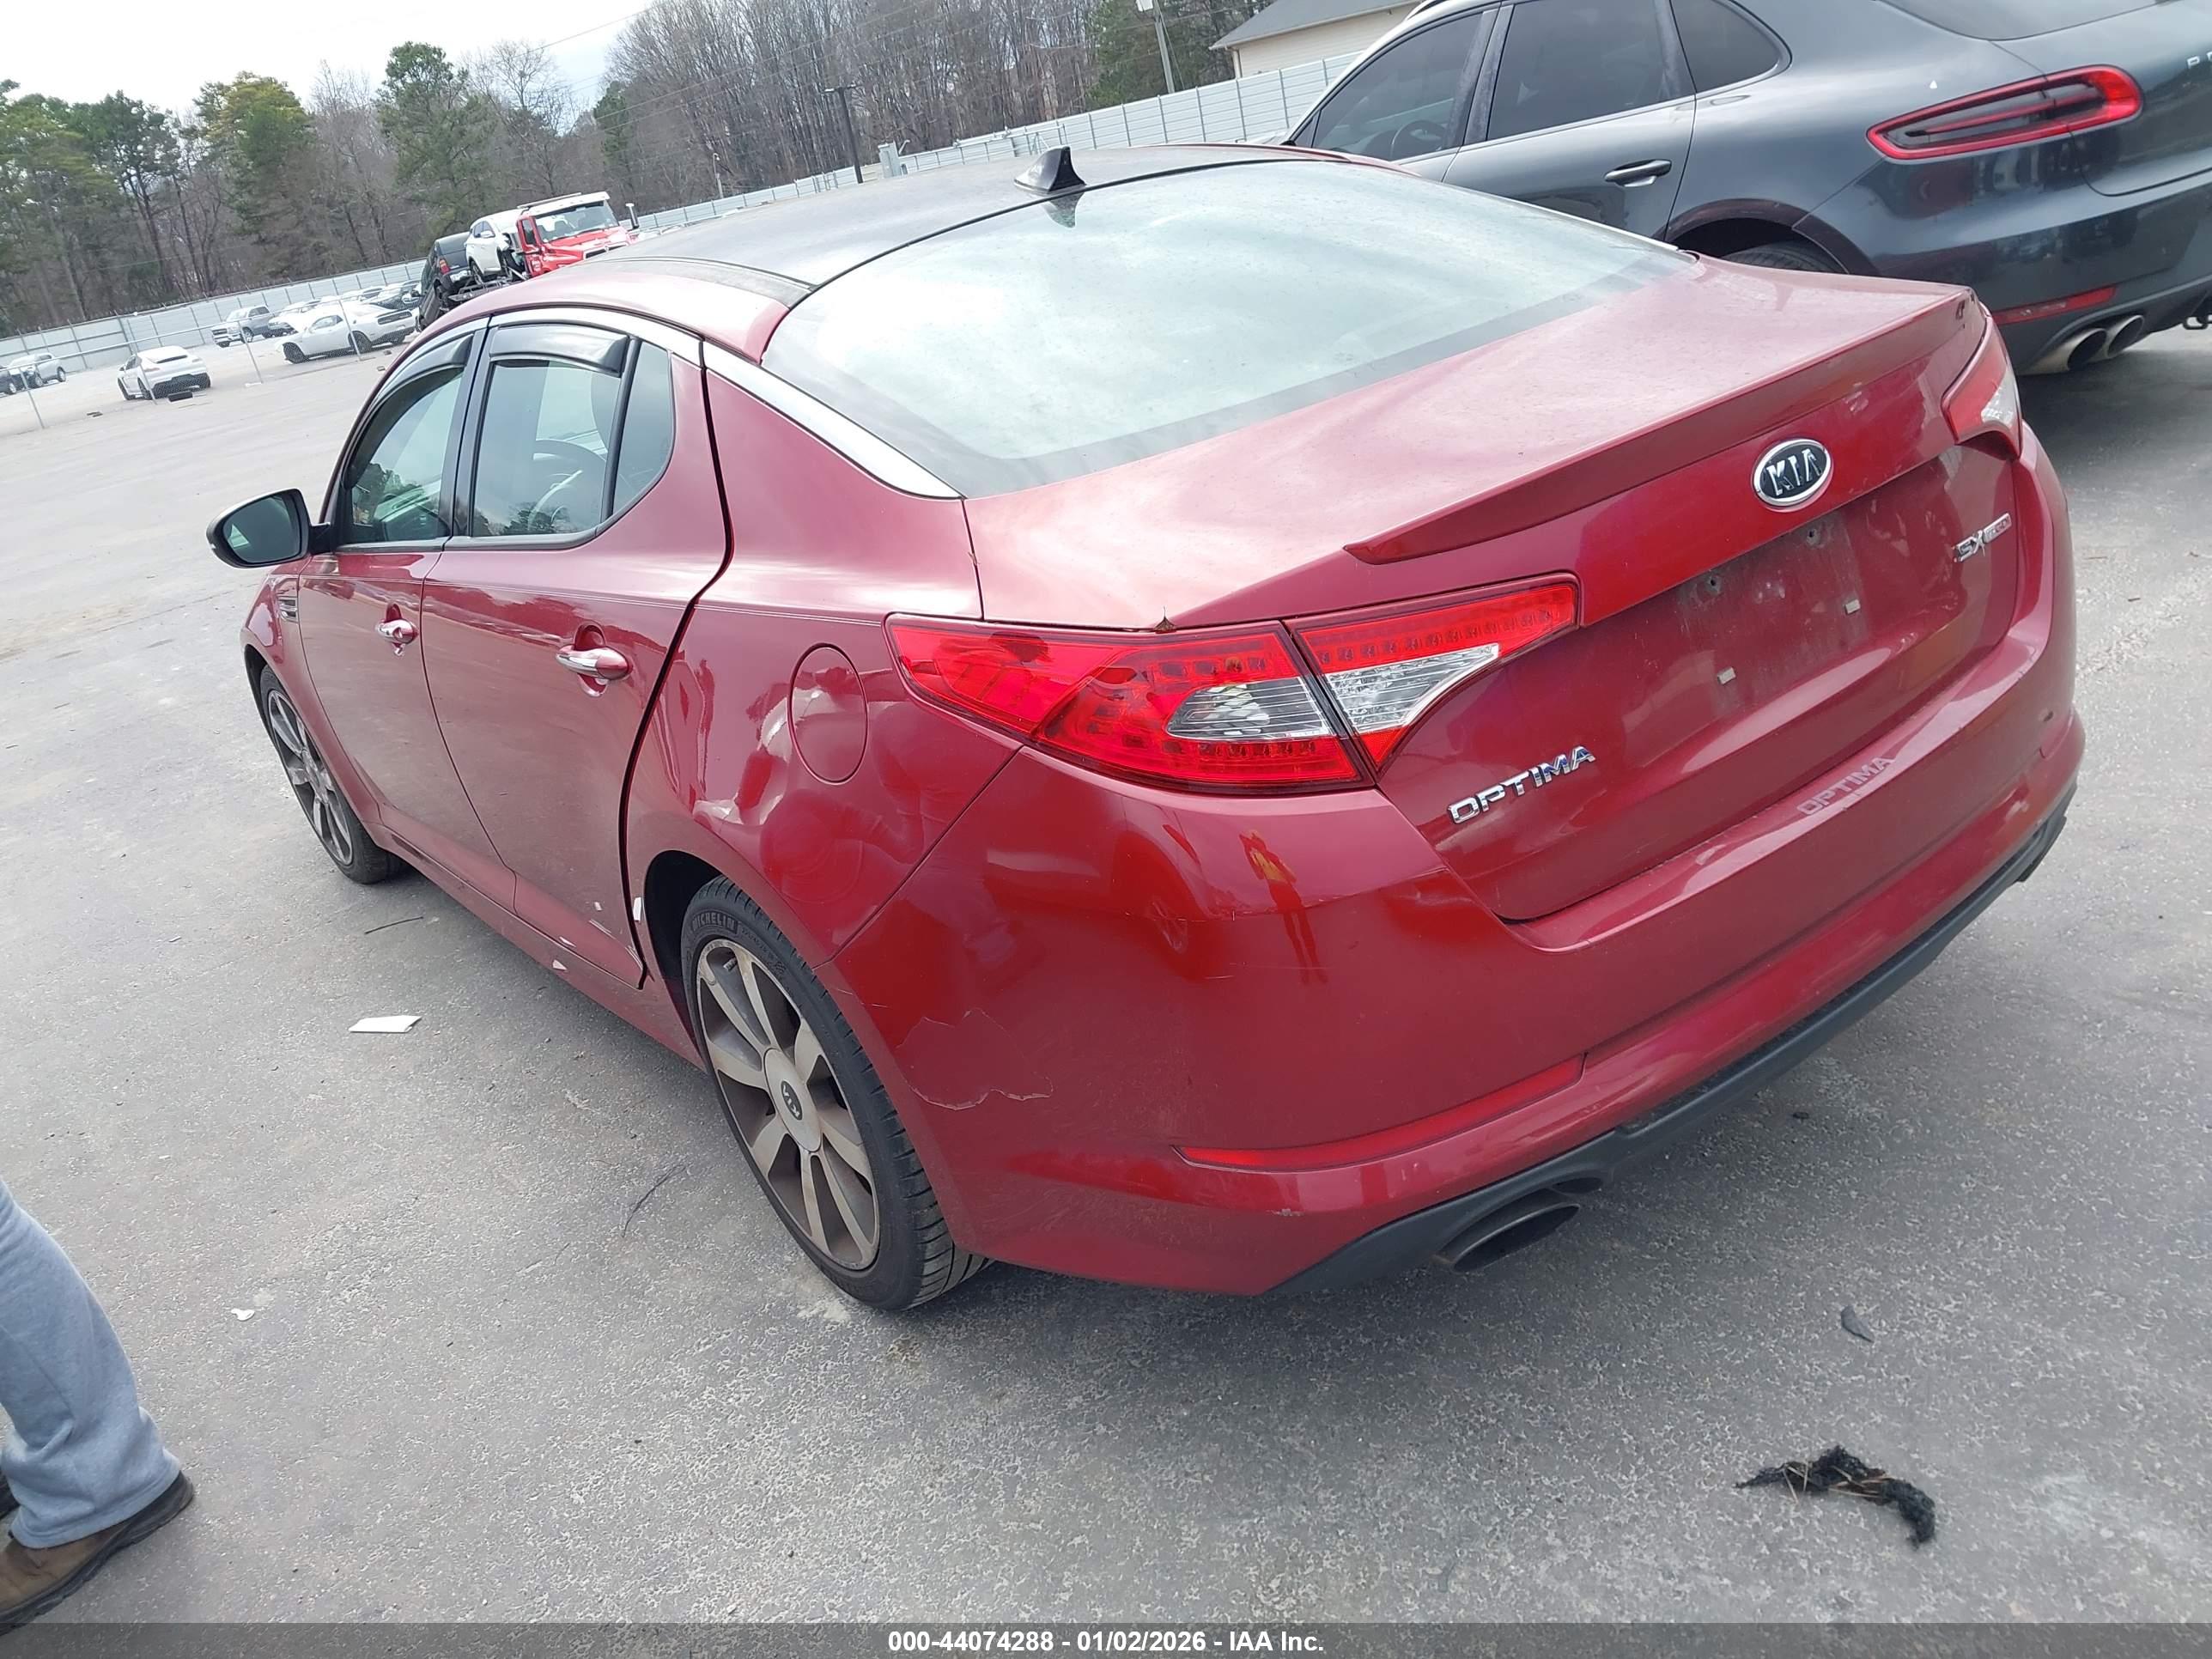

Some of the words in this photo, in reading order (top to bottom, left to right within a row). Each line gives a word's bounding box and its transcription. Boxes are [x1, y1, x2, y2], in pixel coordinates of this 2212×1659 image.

[1765, 448, 1821, 496] KIA
[1957, 530, 1985, 562] SX
[1447, 745, 1596, 824] OPTIMA
[1796, 757, 1895, 816] OPTIMA
[691, 911, 737, 933] MICHELIN
[782, 1084, 800, 1118] KIA
